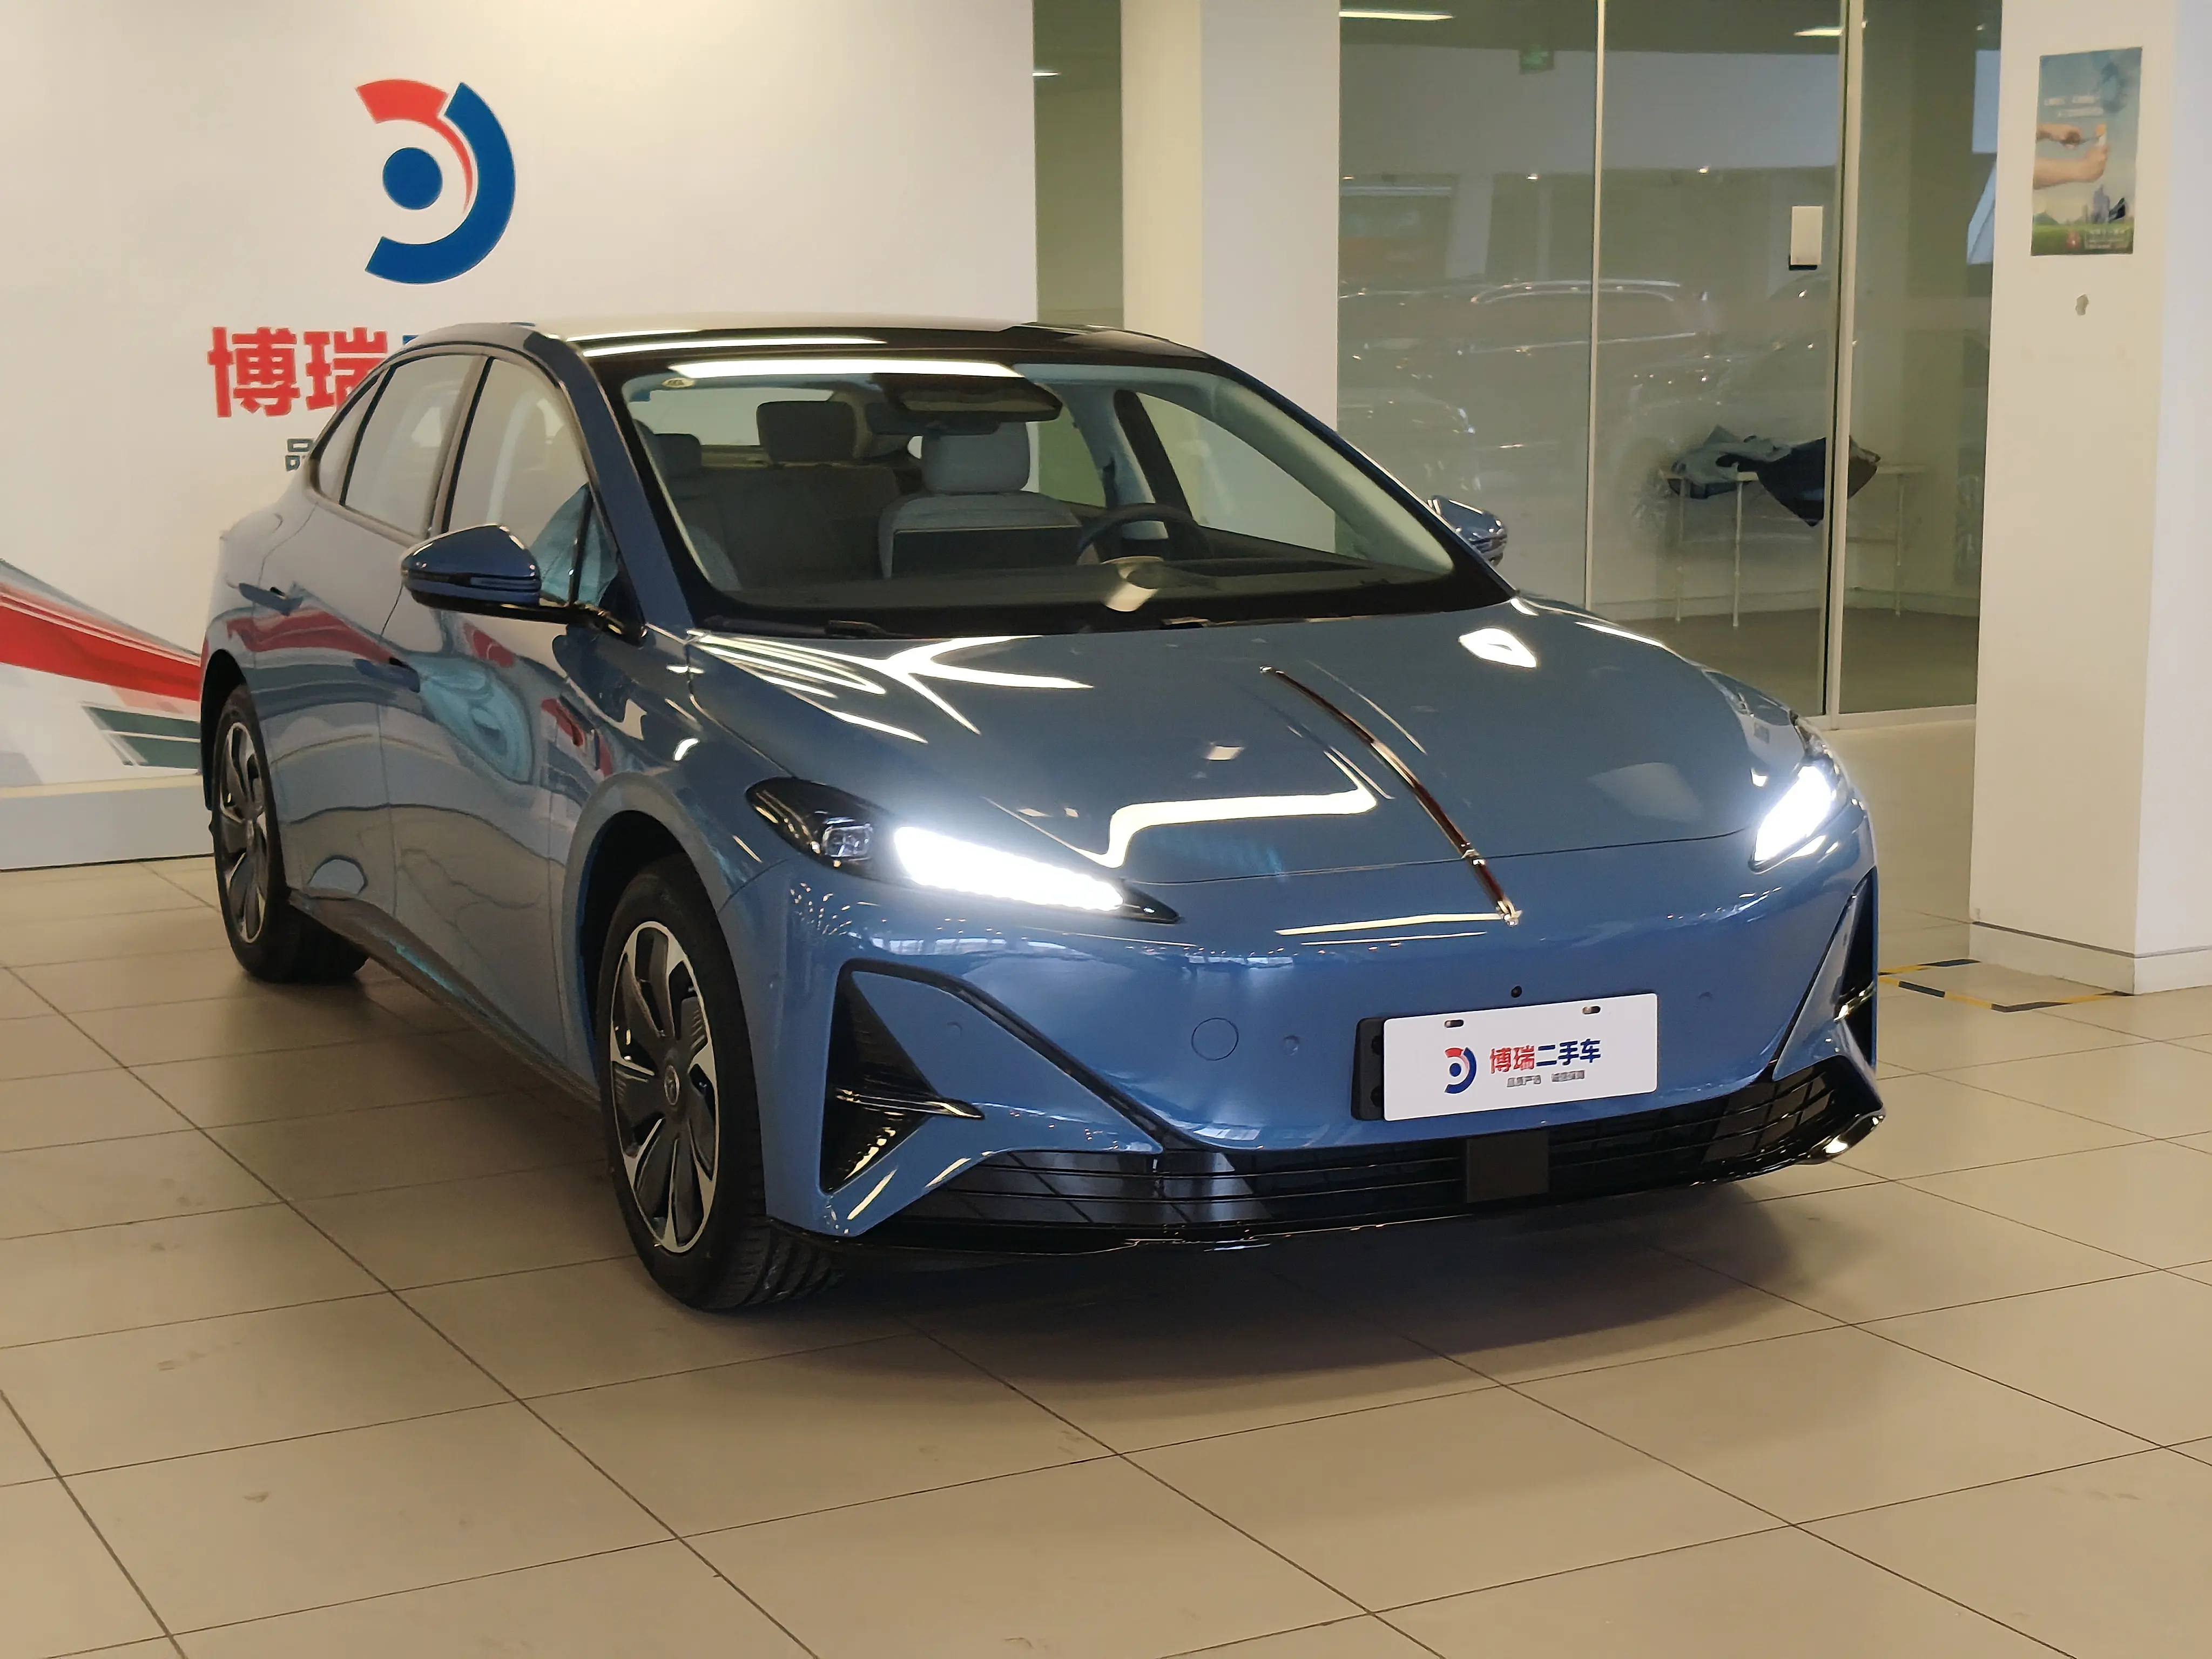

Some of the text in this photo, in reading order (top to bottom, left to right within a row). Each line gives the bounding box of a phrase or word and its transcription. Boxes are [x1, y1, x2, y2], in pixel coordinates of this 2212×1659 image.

[207, 326, 419, 417] 博瑞
[1489, 1038, 1601, 1074] 博瑞二手车
